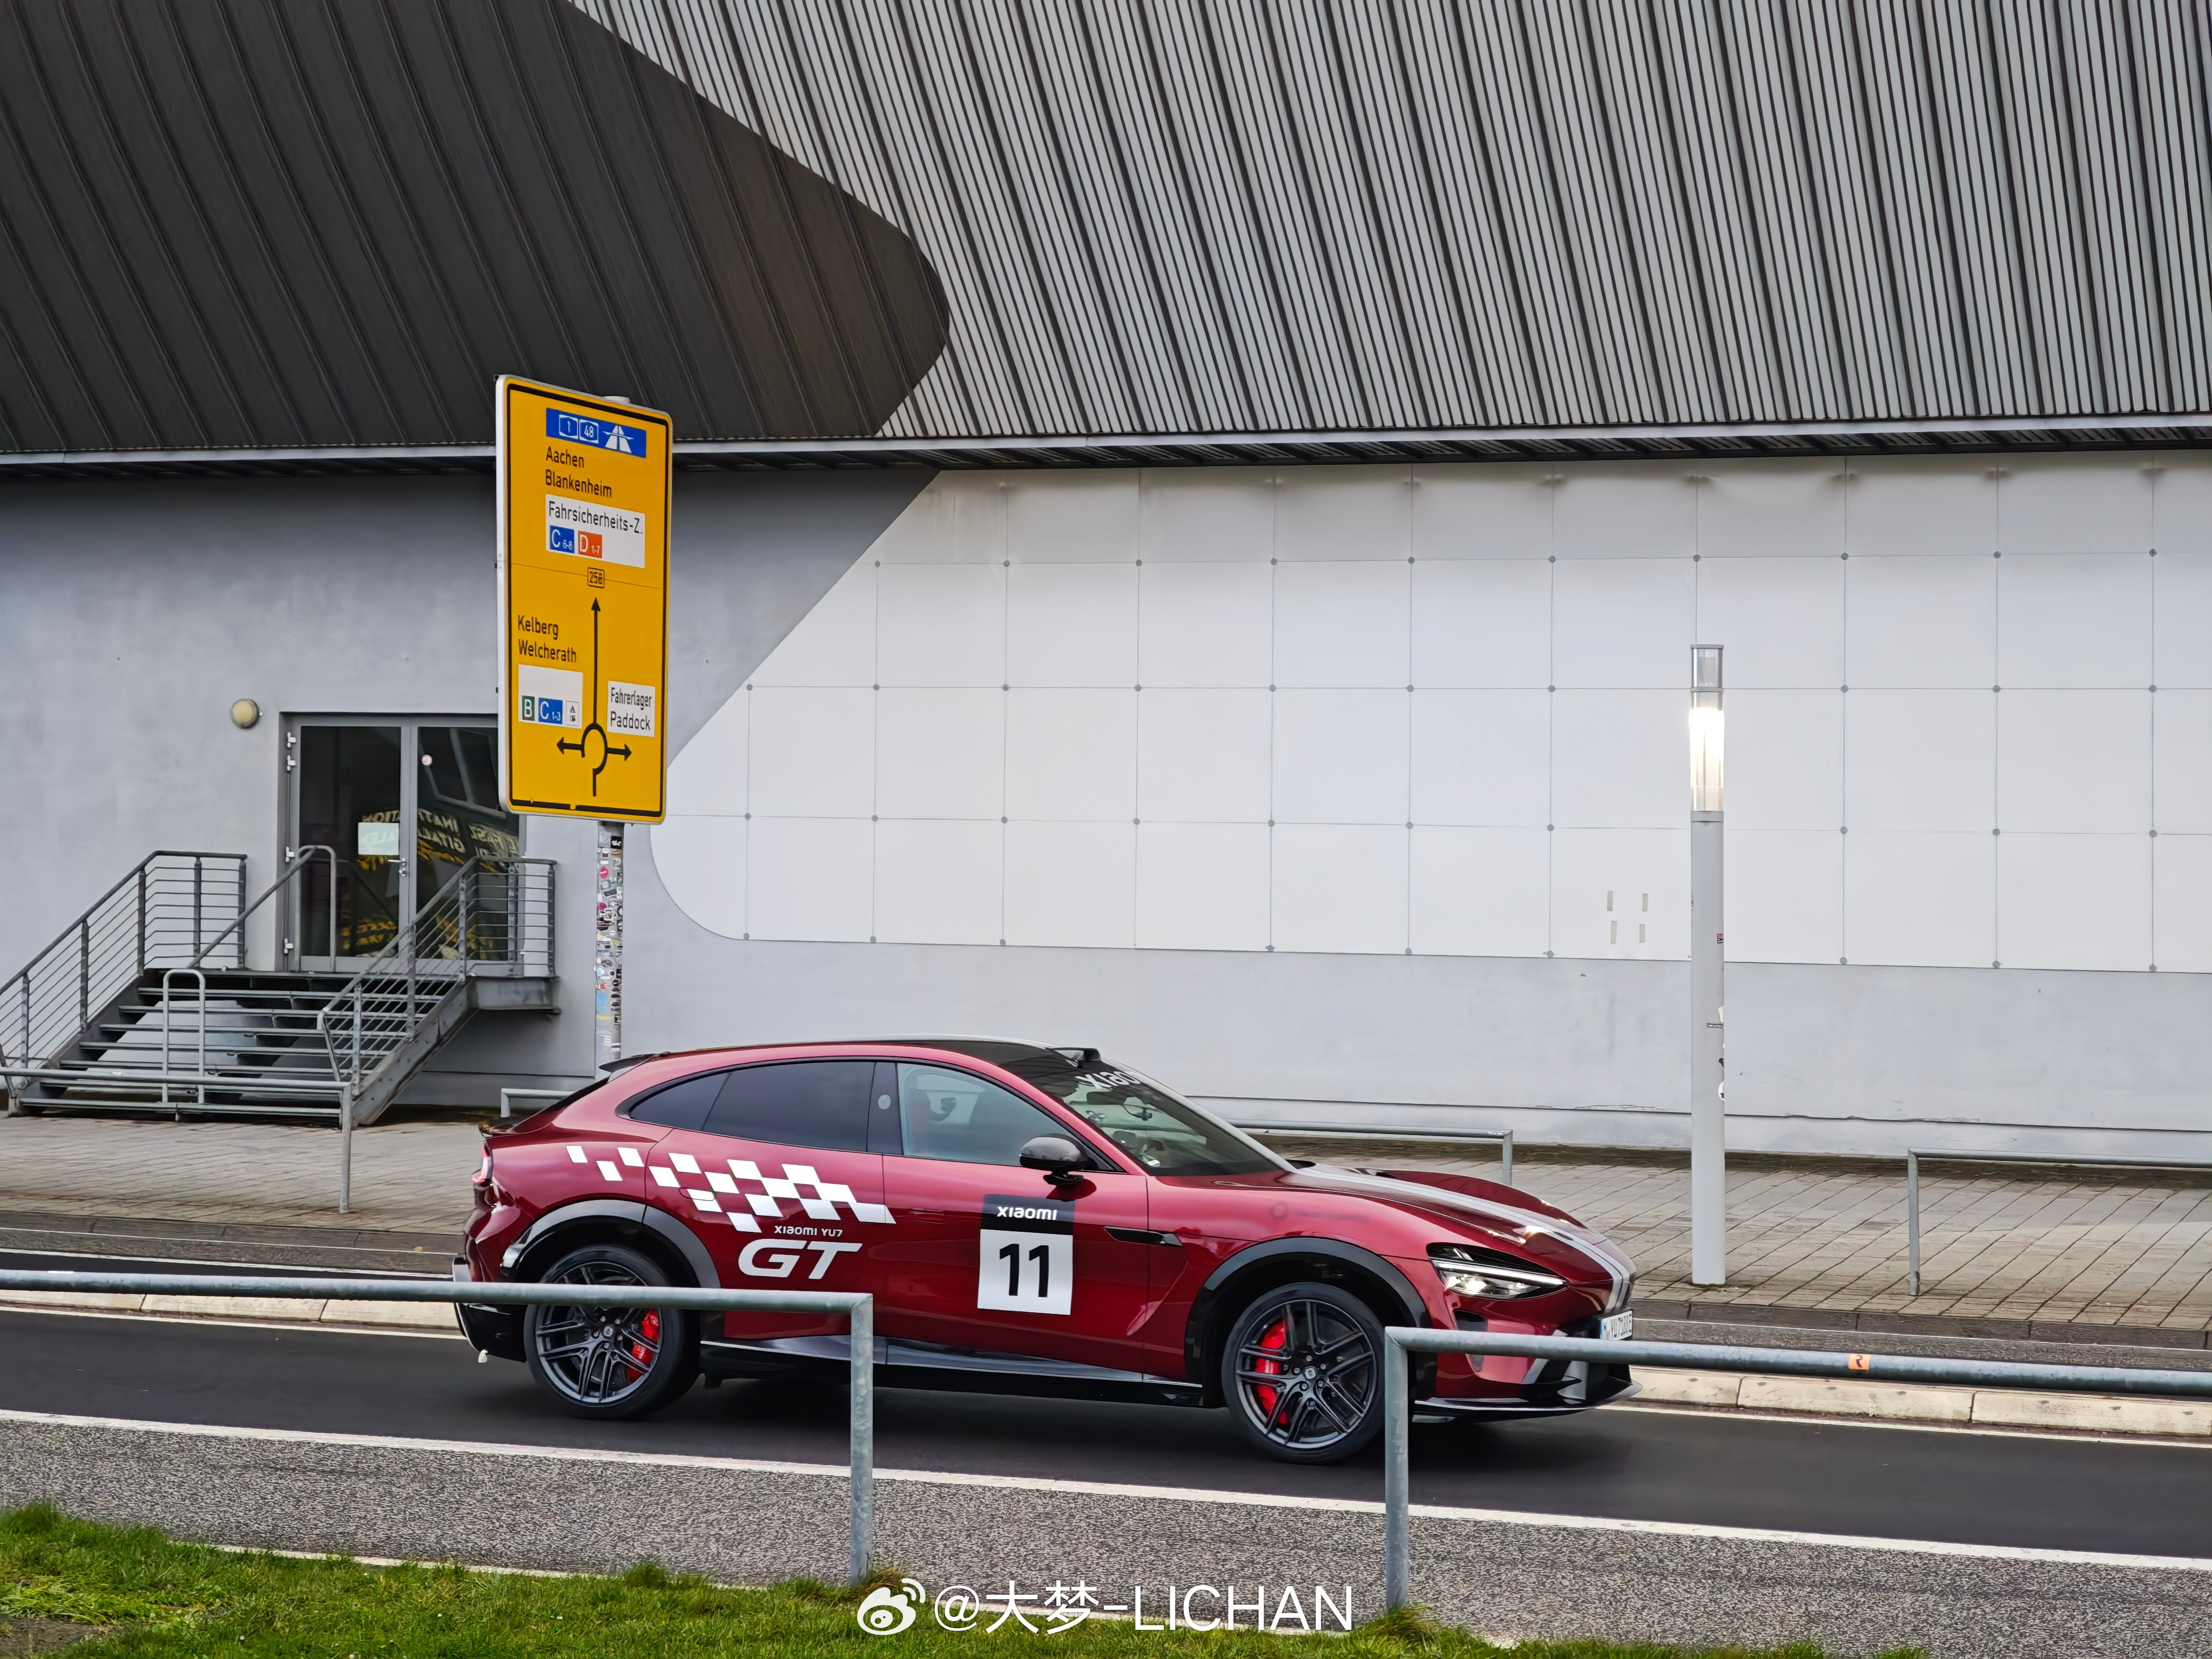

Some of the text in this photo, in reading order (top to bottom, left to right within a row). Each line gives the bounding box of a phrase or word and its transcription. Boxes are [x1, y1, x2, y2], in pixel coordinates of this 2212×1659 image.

[567, 420, 594, 438] 1 48
[545, 446, 585, 468] Aachen
[545, 469, 612, 498] Blankenheim
[548, 500, 643, 534] Fahrsicherheits-Z.
[589, 571, 603, 585] 258
[517, 614, 559, 640] Kelberg
[518, 638, 577, 663] Welcherath
[524, 698, 532, 718] B
[611, 686, 652, 711] Fahrerlager
[610, 711, 650, 731] Paddock
[821, 1229, 842, 1237] YU7
[738, 1238, 863, 1279] GT
[1000, 1243, 1049, 1298] 11
